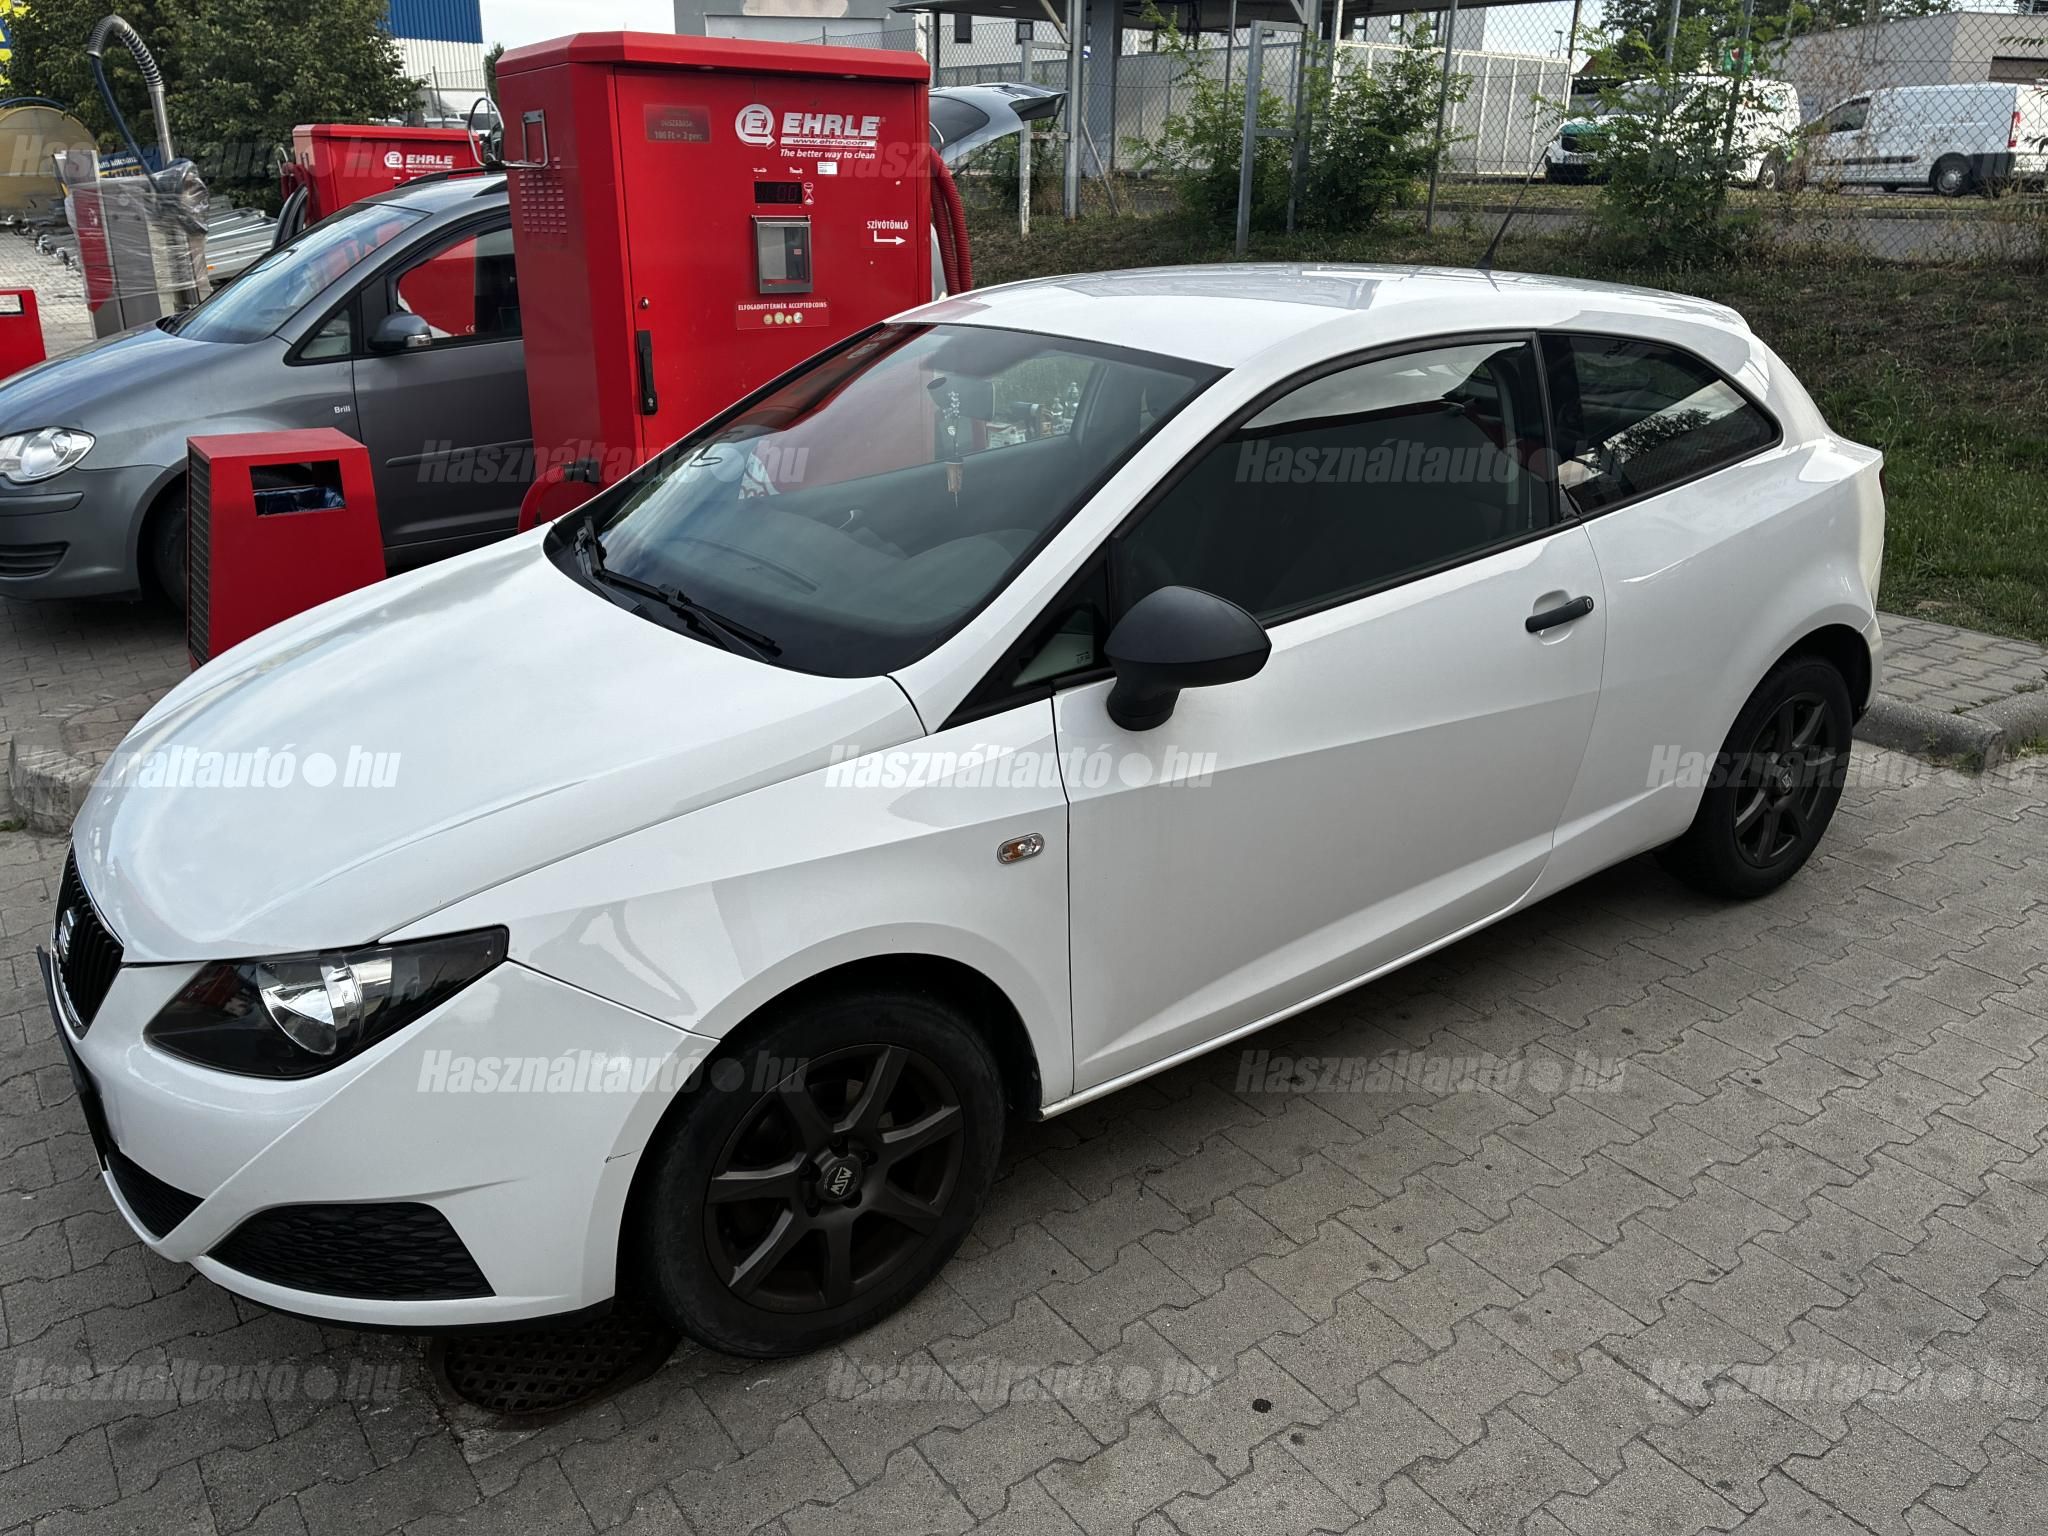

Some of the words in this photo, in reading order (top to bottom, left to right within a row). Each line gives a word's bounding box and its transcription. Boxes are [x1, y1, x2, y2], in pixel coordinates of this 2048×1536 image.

[782, 112, 880, 137] EHRLE
[406, 154, 453, 164] EHRLE
[780, 149, 795, 157] The
[797, 150, 821, 158] better
[824, 151, 842, 160] way
[844, 151, 853, 159] to
[854, 151, 875, 159] clean
